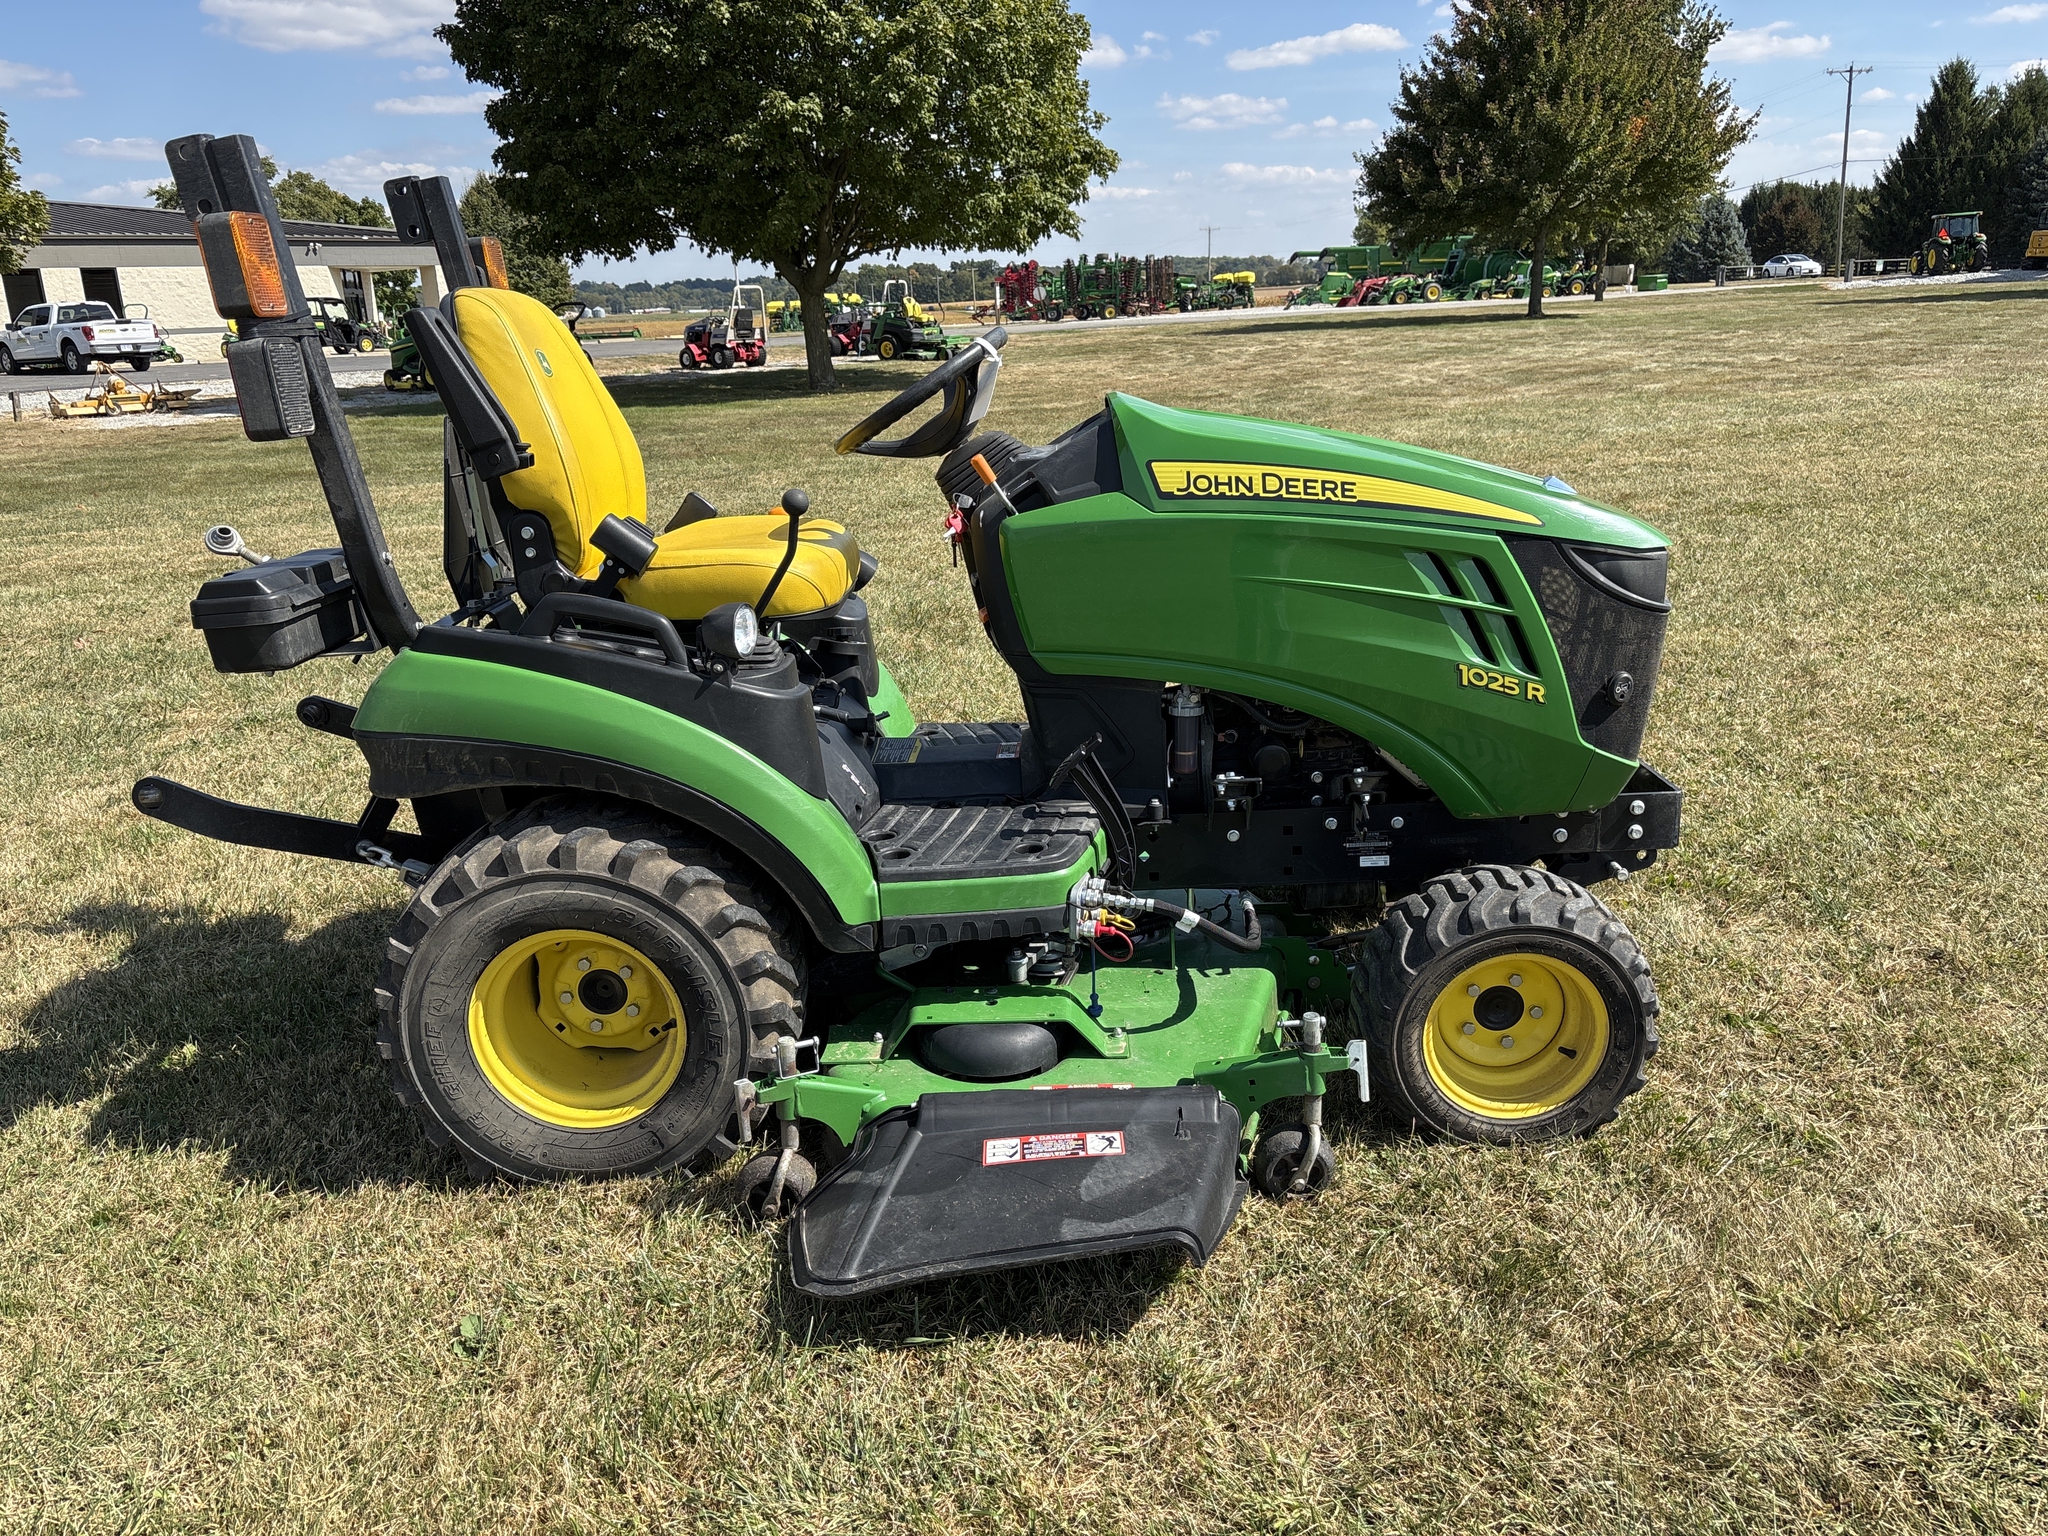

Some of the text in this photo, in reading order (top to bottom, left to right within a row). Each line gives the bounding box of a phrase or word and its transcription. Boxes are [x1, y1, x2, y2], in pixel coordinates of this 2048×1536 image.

[1176, 470, 1357, 499] JOHN DEERE
[1457, 663, 1545, 704] 1025 R
[606, 907, 724, 1057] CARLISLE
[425, 1021, 538, 1160] TRAC CHIEF
